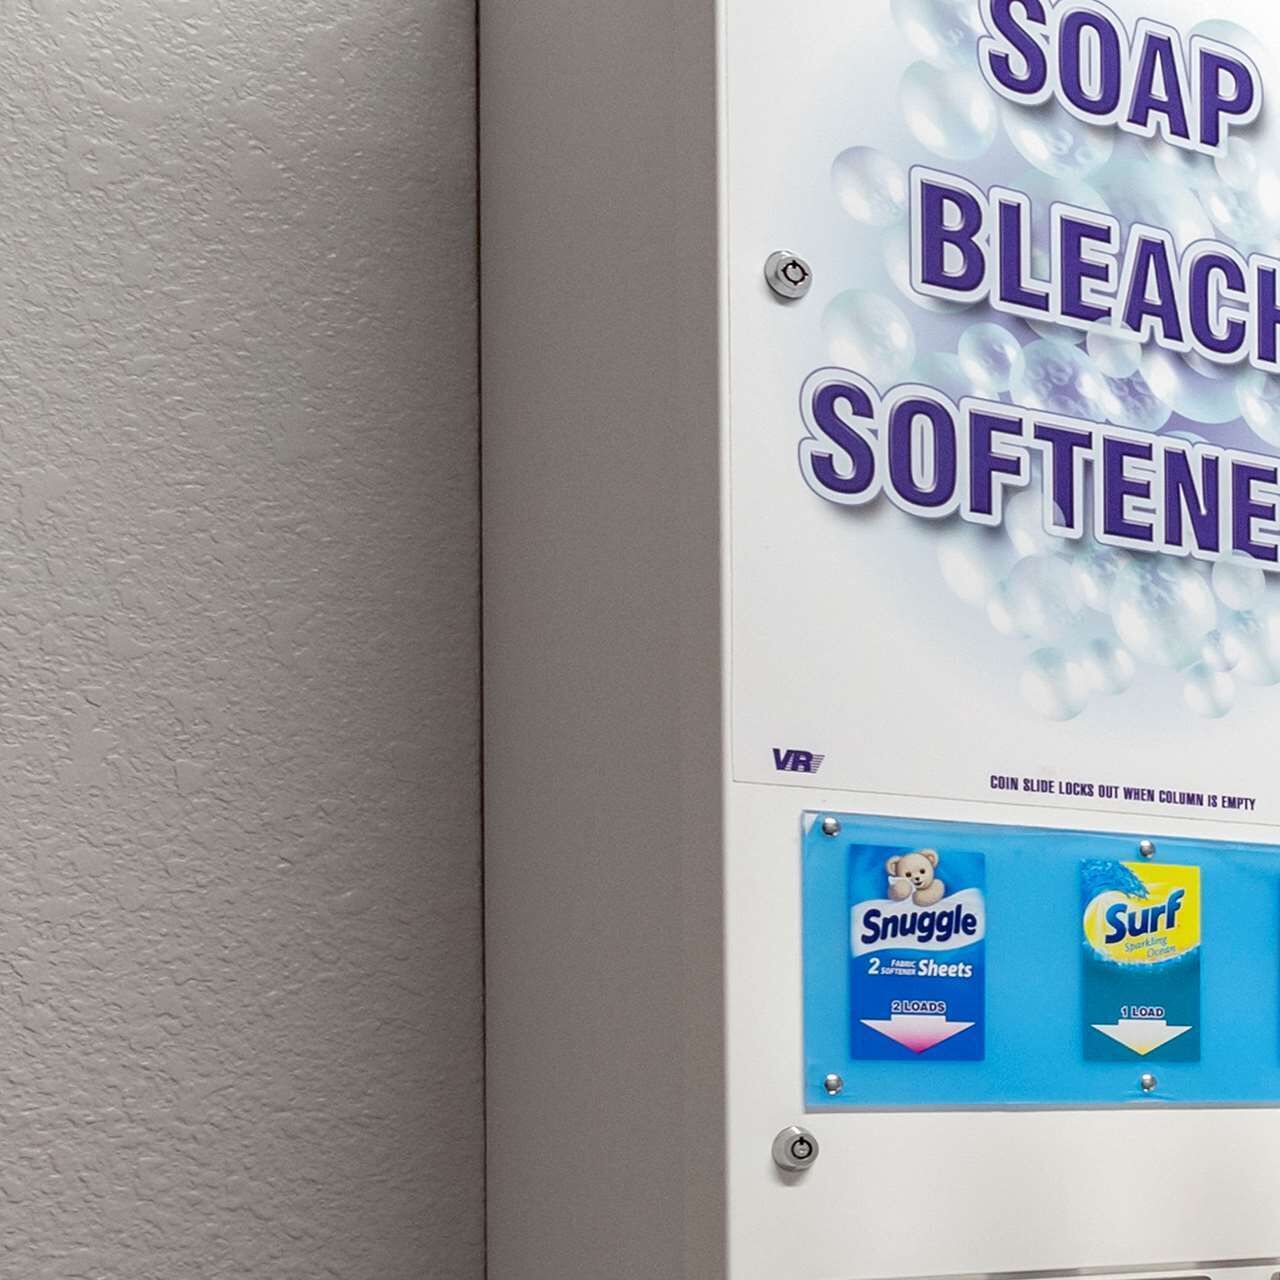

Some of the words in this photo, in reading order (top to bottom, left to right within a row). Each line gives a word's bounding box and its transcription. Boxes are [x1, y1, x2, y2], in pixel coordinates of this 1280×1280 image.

[986, 0, 1255, 149] SOAP
[990, 775, 1018, 791] COIN
[1023, 778, 1055, 794] SLIDE
[1059, 781, 1094, 797] LOCKS
[1098, 784, 1119, 799] OUT
[1123, 786, 1154, 803] WHEN
[1159, 790, 1204, 806] COLUMN
[1207, 795, 1218, 808] IS
[1221, 795, 1256, 811] EMPTY
[861, 904, 977, 944] Snuggle
[1104, 888, 1185, 944] Surf
[1124, 936, 1168, 952] Sparkling
[1146, 945, 1176, 958] Ocean
[868, 957, 880, 975] 2
[917, 959, 973, 977] Sheets
[892, 1000, 901, 1012] 2
[904, 1000, 946, 1013] LOADS
[1121, 1006, 1128, 1017] 1
[1131, 1006, 1165, 1018] LOAD
